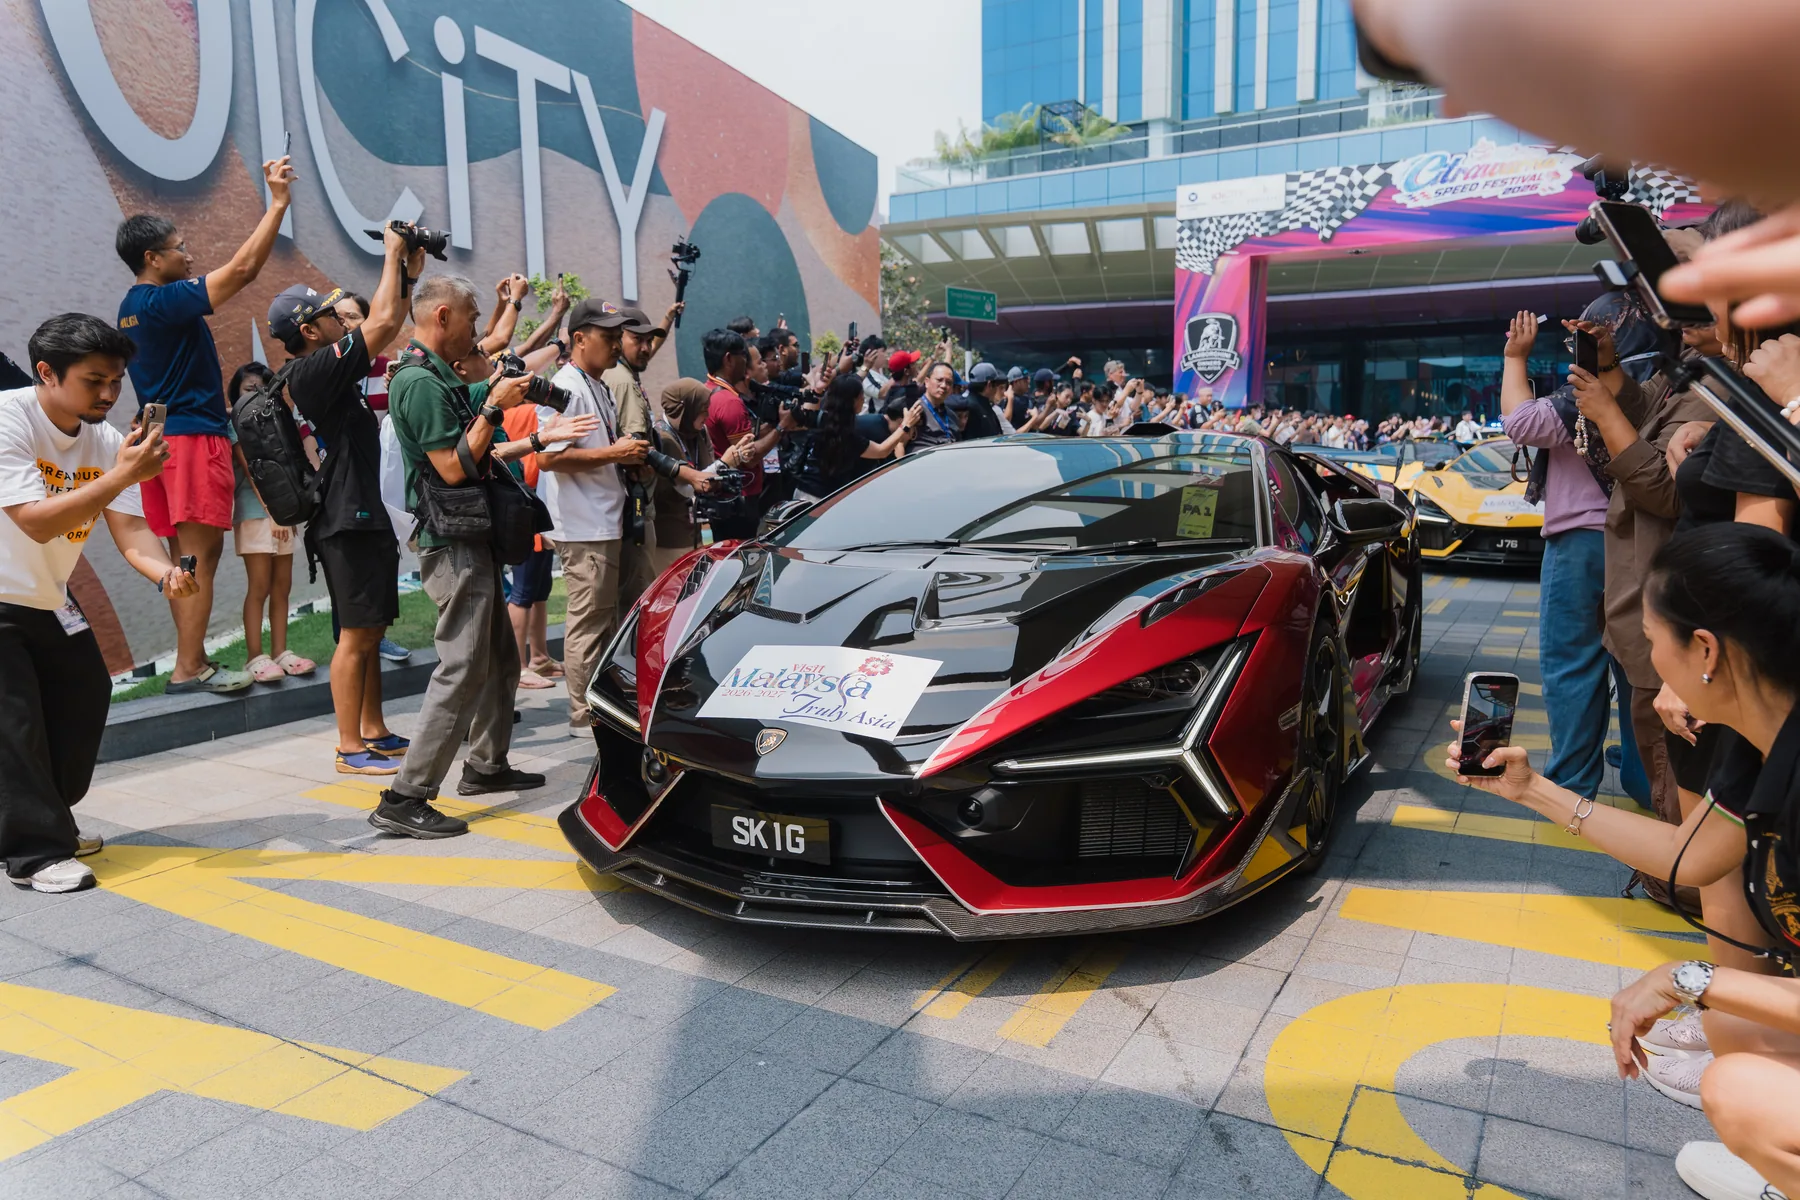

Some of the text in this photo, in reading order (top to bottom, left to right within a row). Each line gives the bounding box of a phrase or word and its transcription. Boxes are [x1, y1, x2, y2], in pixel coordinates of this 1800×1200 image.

[1434, 173, 1544, 198] SPEED FESTIVAL
[1501, 184, 1541, 196] 2026
[793, 663, 826, 673] Visit
[720, 667, 873, 705] Malaysia
[780, 693, 896, 729] Truly Asia
